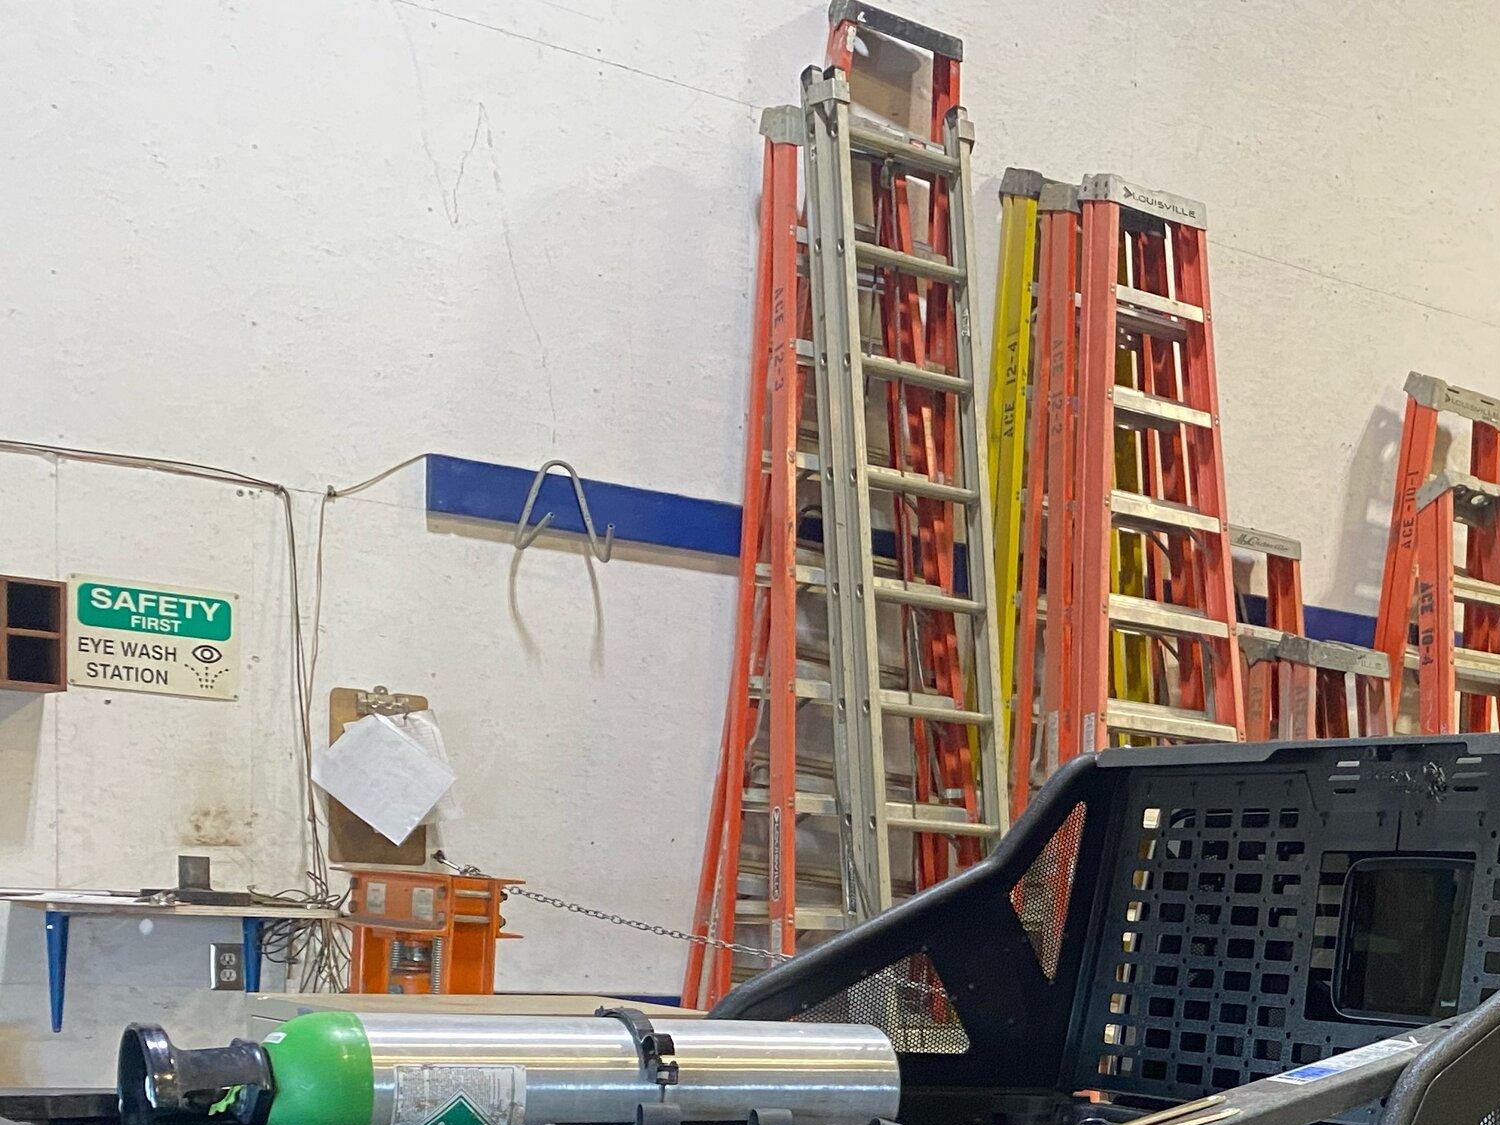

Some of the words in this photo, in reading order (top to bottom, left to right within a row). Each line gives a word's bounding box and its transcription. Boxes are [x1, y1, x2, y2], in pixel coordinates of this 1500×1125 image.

[1131, 191, 1197, 219] LOUISVILLE
[774, 287, 784, 326] ACE
[774, 342, 784, 391] 12-3
[1004, 401, 1015, 437] ACE
[1402, 517, 1414, 548] ACE
[90, 587, 221, 622] SAFETY
[1420, 582, 1434, 615] ACE
[130, 615, 182, 633] FIRST
[77, 636, 115, 656] EYE
[120, 641, 177, 662] WASH
[1420, 628, 1434, 666] 10-4
[86, 662, 169, 685] STATION
